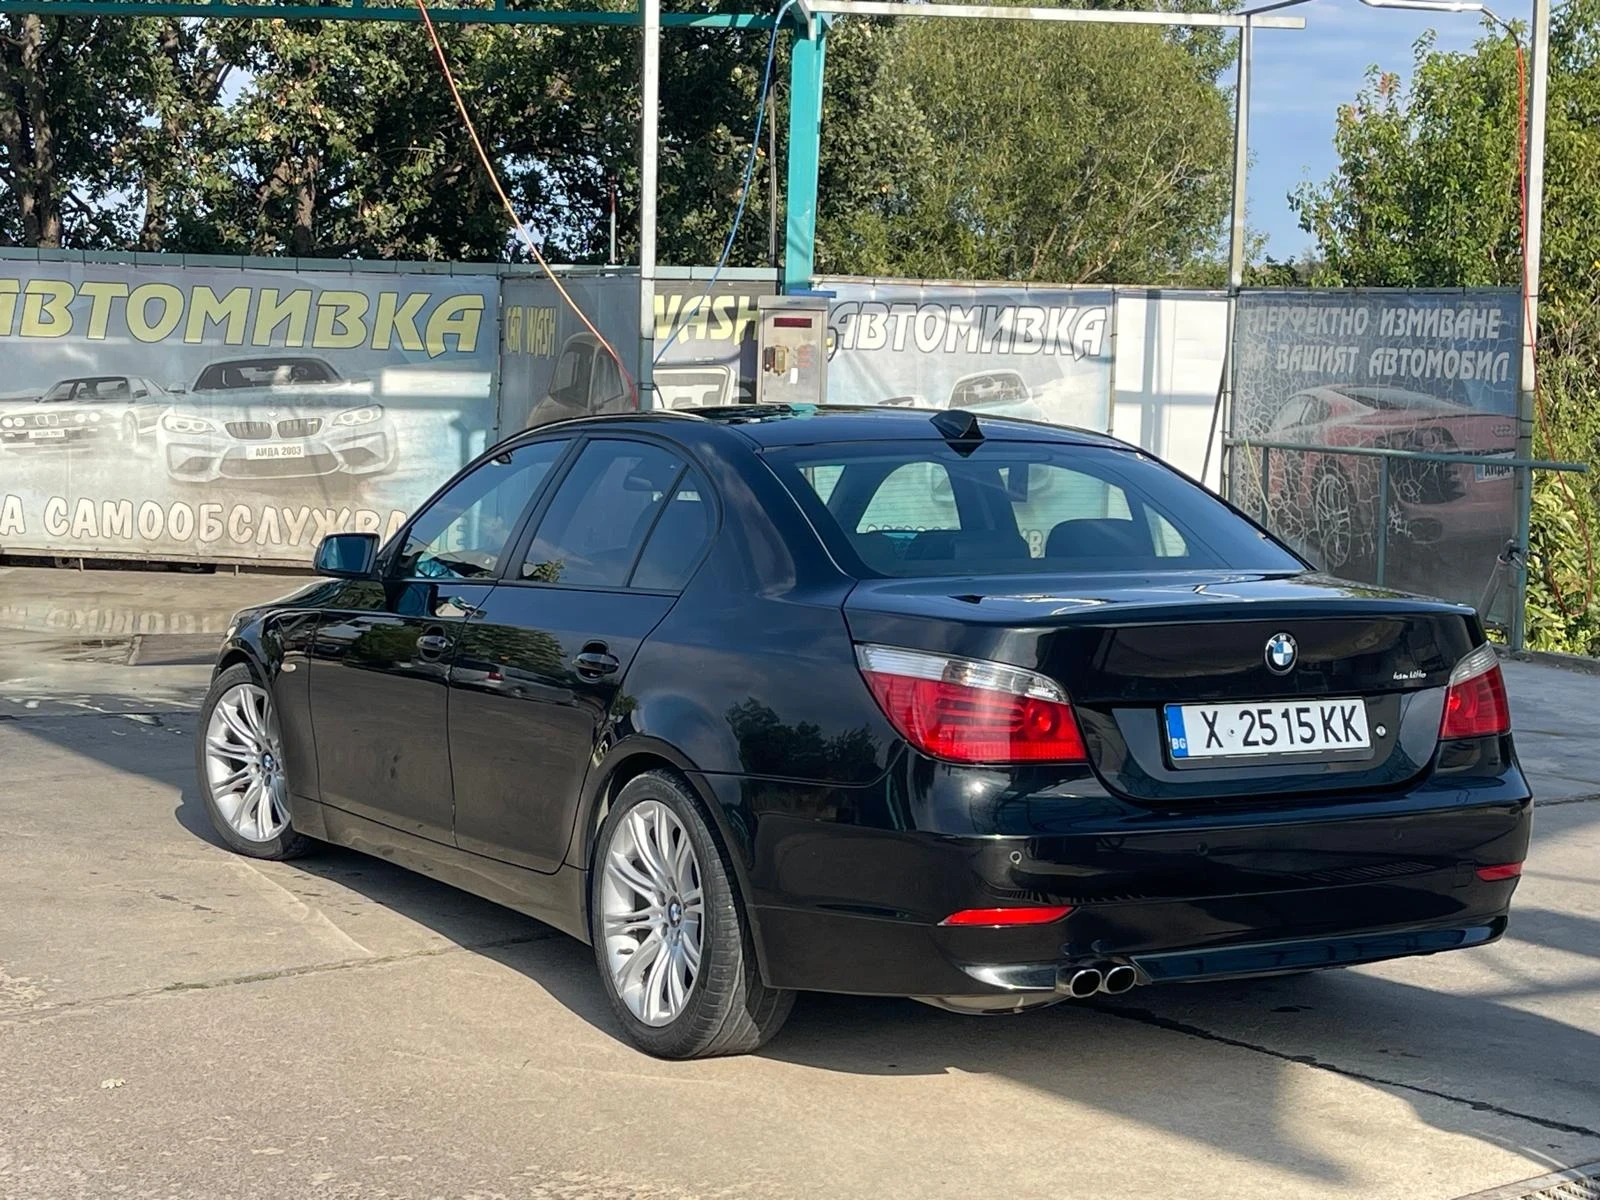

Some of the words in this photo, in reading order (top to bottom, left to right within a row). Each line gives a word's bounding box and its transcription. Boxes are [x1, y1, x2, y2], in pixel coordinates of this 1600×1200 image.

[526, 306, 557, 360] WASH
[829, 301, 1107, 361] АВТОМИВКА
[1251, 306, 1369, 337] ПЕРФЕКТНО
[1380, 308, 1501, 341] ИЗМИВАНЕ
[1277, 343, 1359, 375] ВАШИЯТ
[1369, 347, 1510, 384] АВТОМОБИЛ
[281, 446, 302, 456] 2003
[1171, 737, 1187, 750] BG
